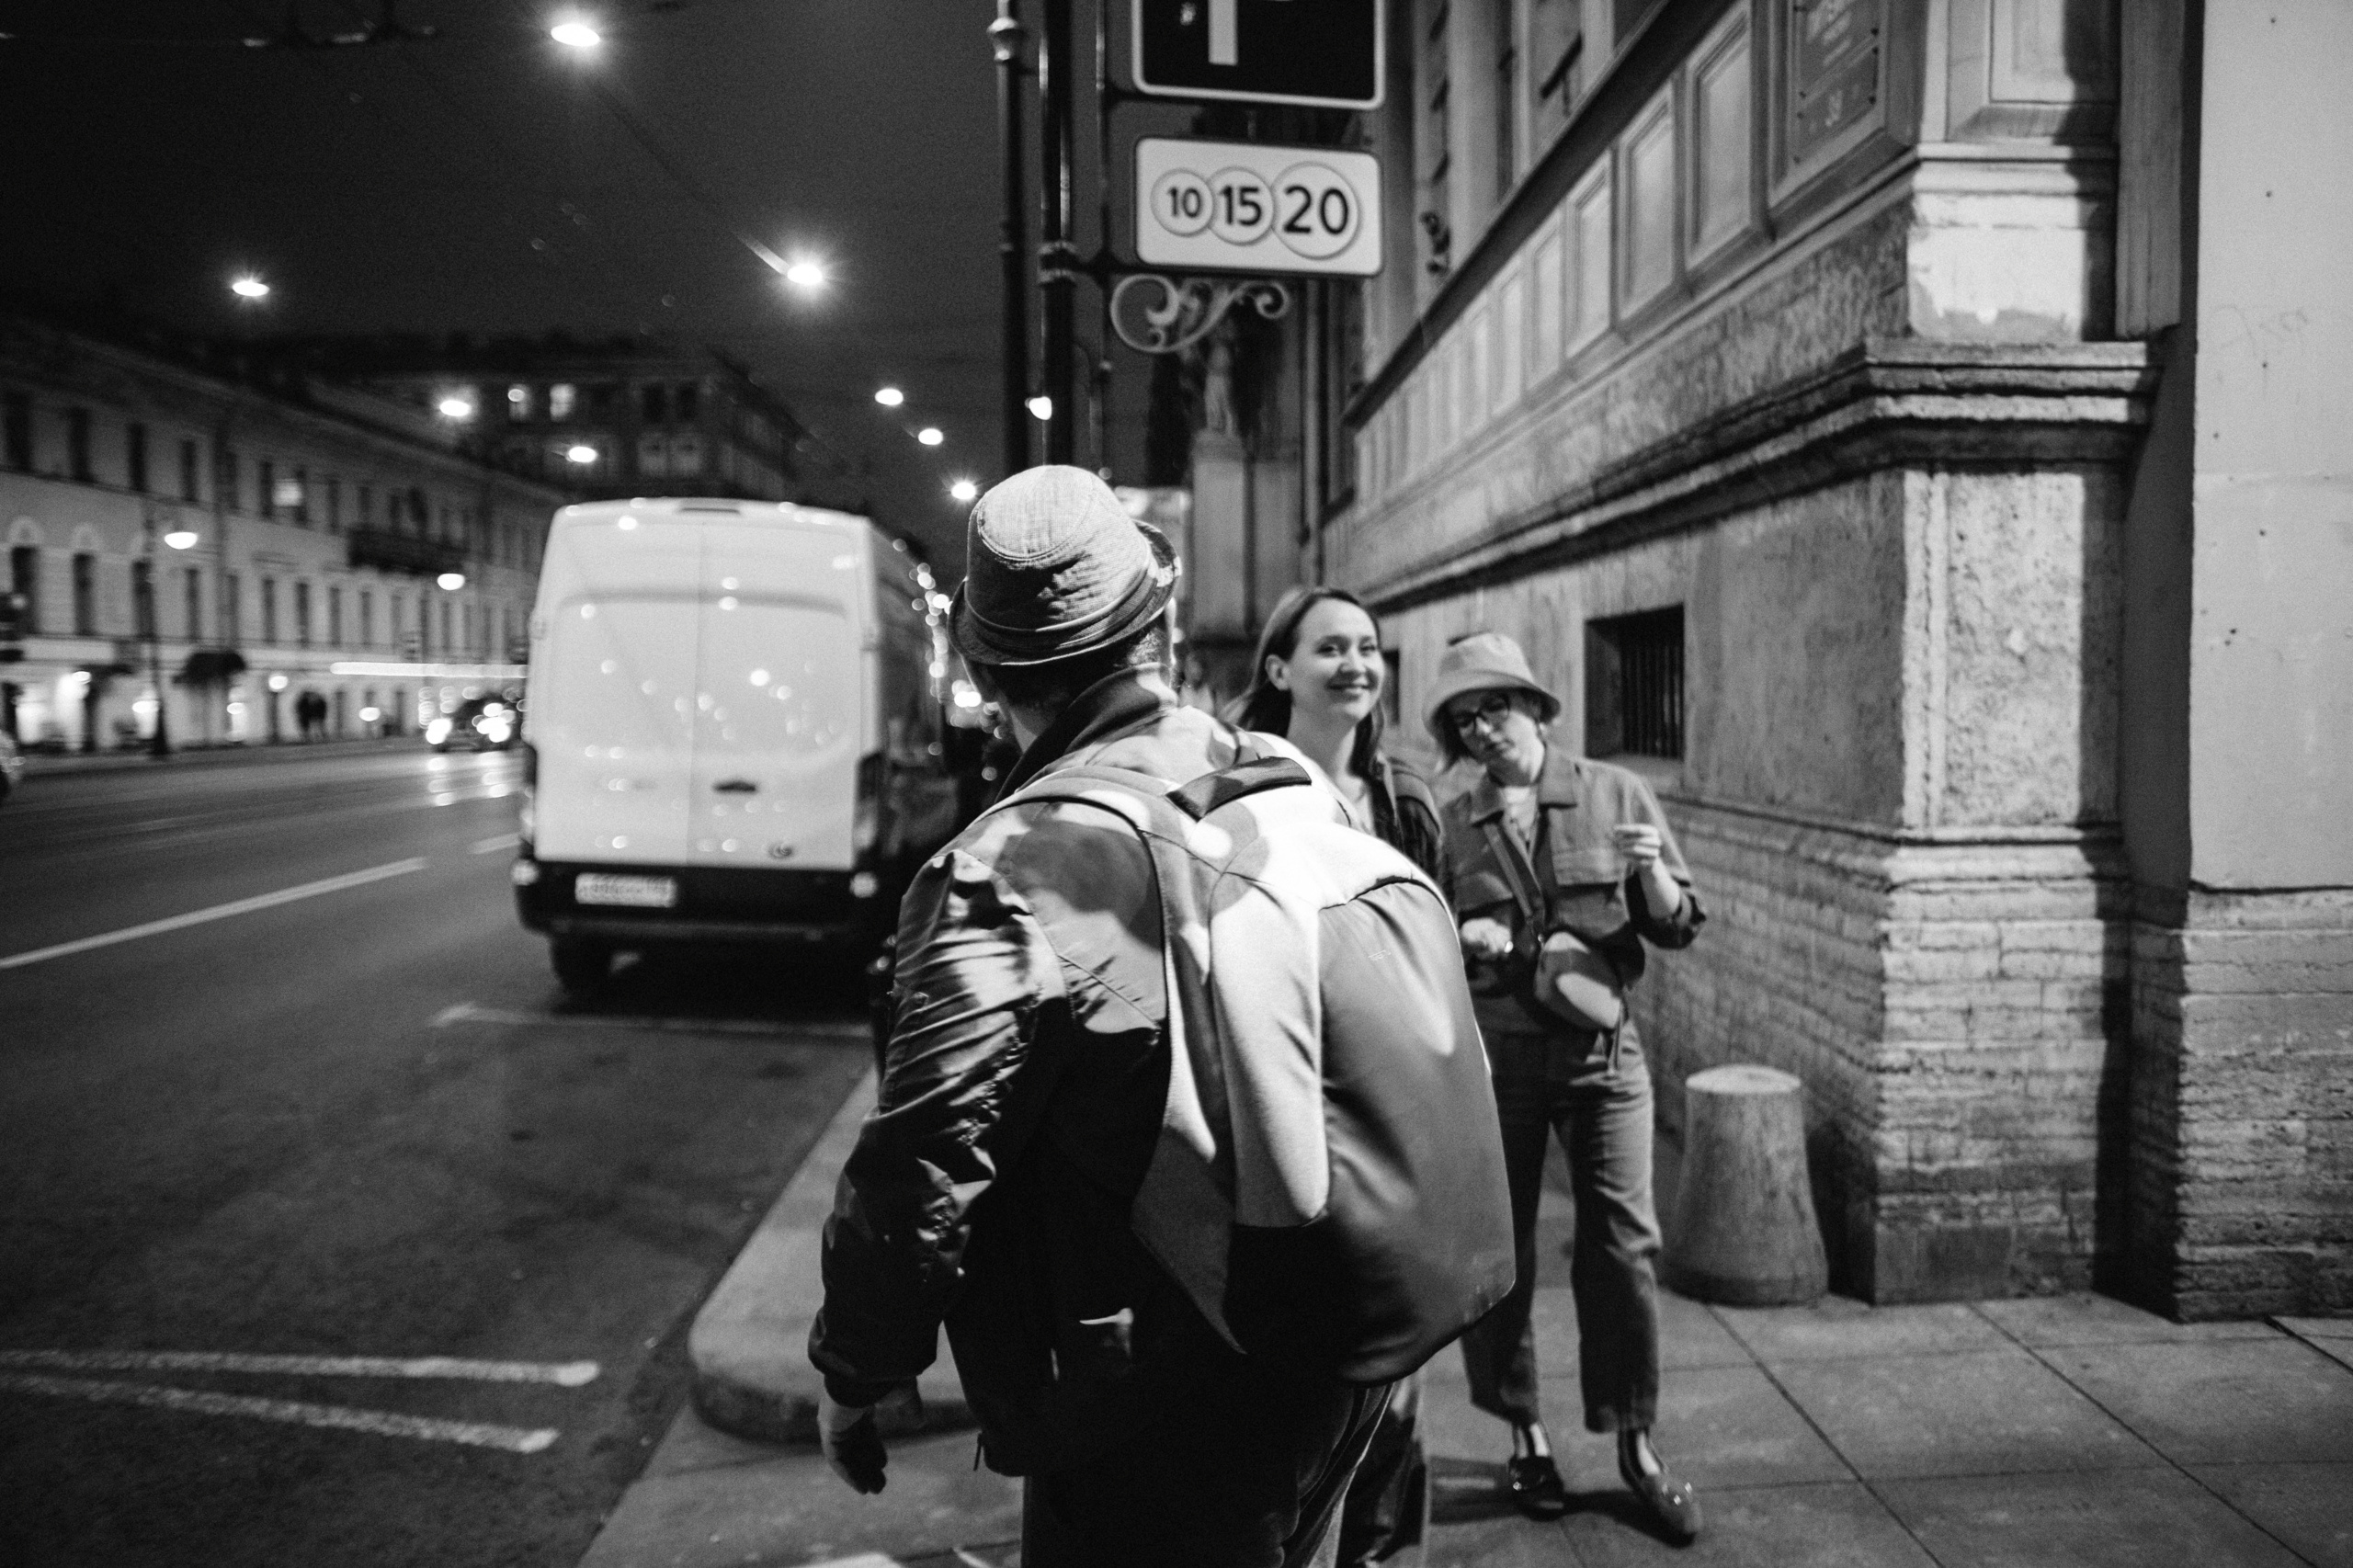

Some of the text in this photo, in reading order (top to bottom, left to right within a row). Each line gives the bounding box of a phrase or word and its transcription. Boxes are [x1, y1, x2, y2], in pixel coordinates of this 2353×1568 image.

[1166, 185, 1349, 235] 10 15 20
